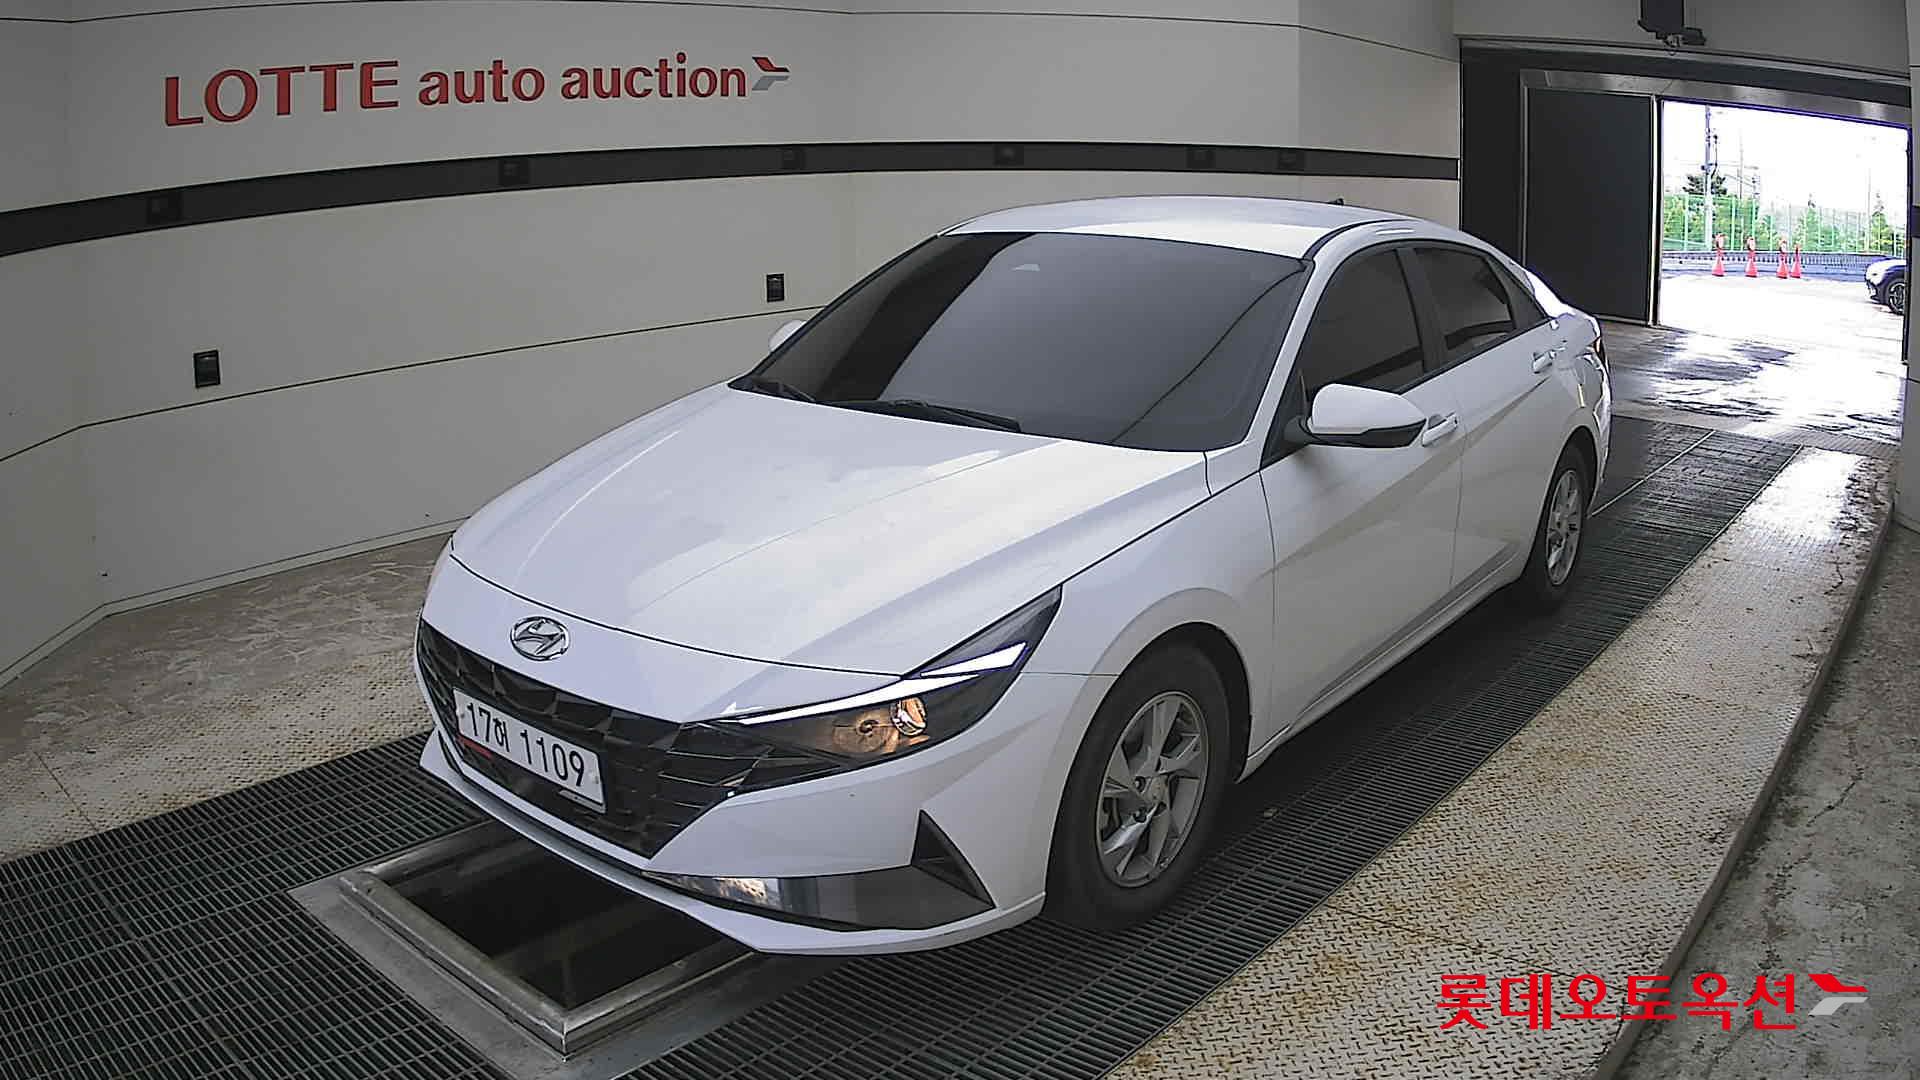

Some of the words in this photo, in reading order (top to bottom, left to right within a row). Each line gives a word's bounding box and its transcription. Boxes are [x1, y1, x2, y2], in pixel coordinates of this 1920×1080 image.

[165, 60, 399, 126] LOTTE
[418, 59, 545, 105] auto
[560, 51, 747, 101] auction
[466, 702, 510, 752] 17허
[520, 729, 585, 787] 1109
